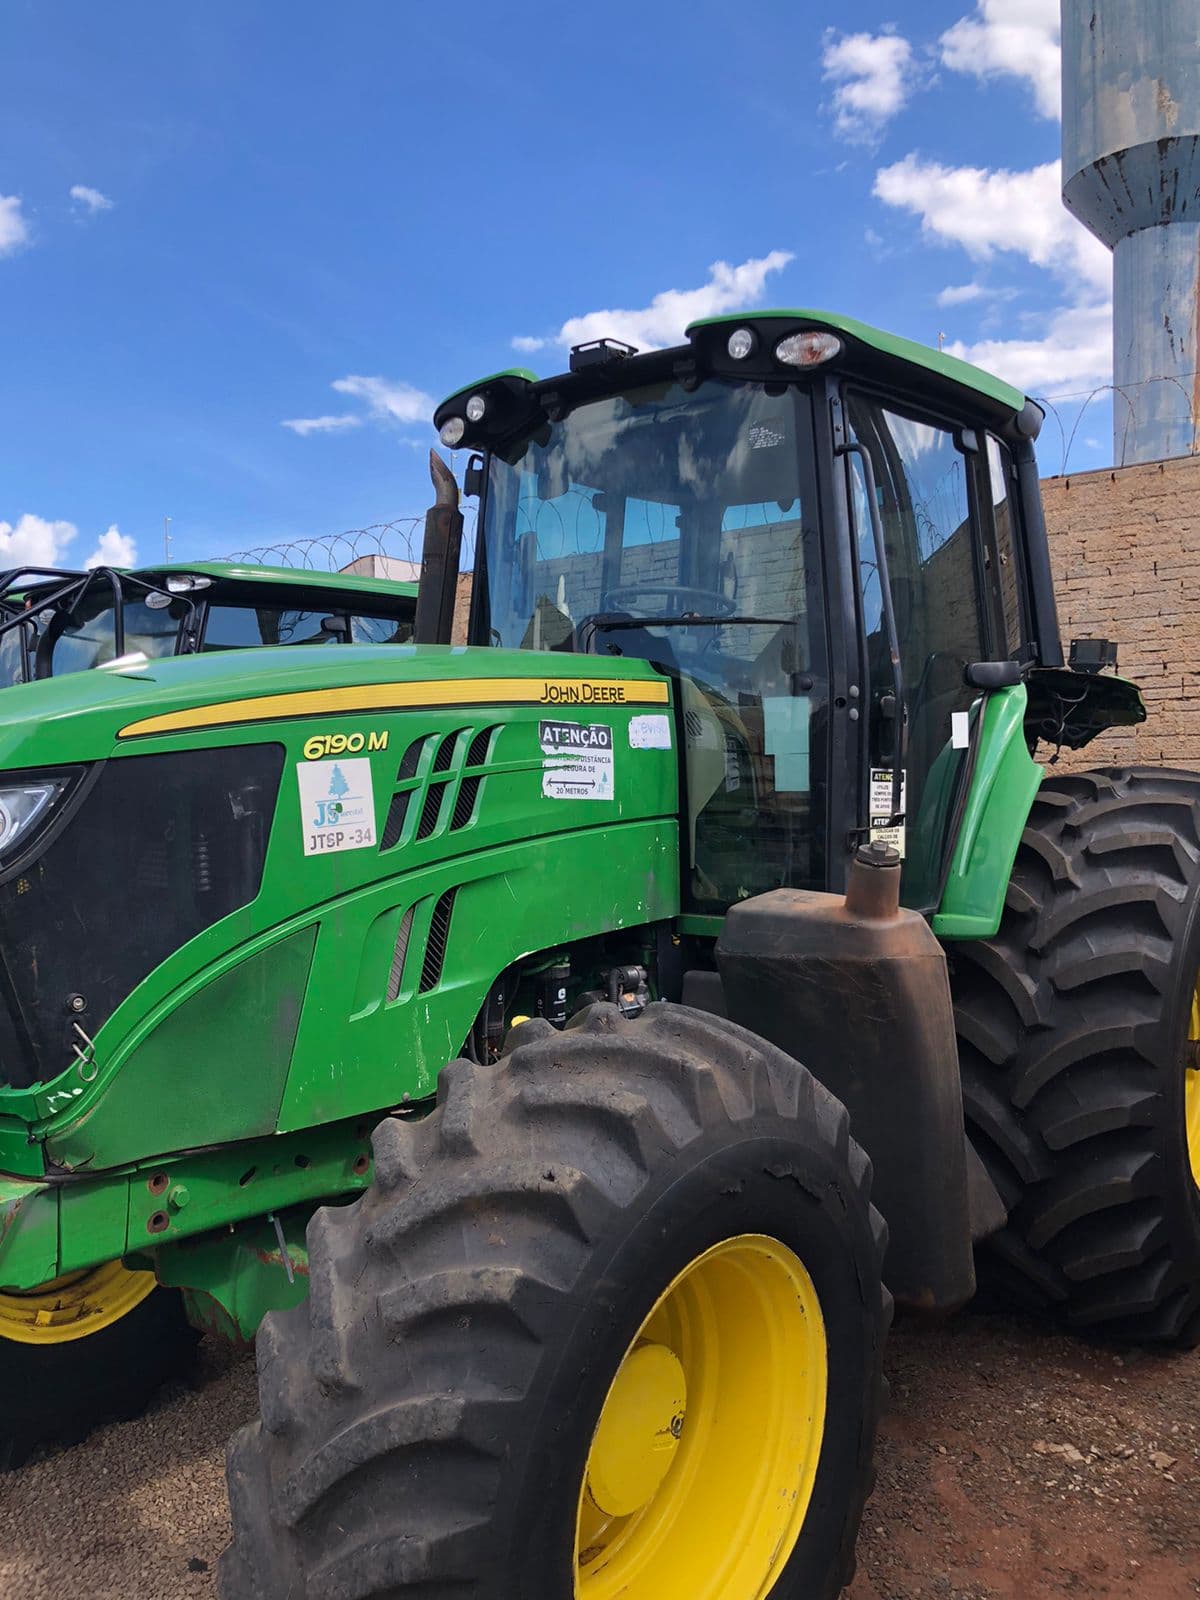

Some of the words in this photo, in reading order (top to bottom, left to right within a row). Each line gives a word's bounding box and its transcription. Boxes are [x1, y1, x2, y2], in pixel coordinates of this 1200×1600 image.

[540, 682, 579, 702] JOHN
[581, 683, 626, 702] DEERE
[303, 732, 366, 760] 6190
[543, 726, 608, 747] ATENÇÃO
[565, 787, 588, 795] METROS
[310, 831, 345, 850] JTSP
